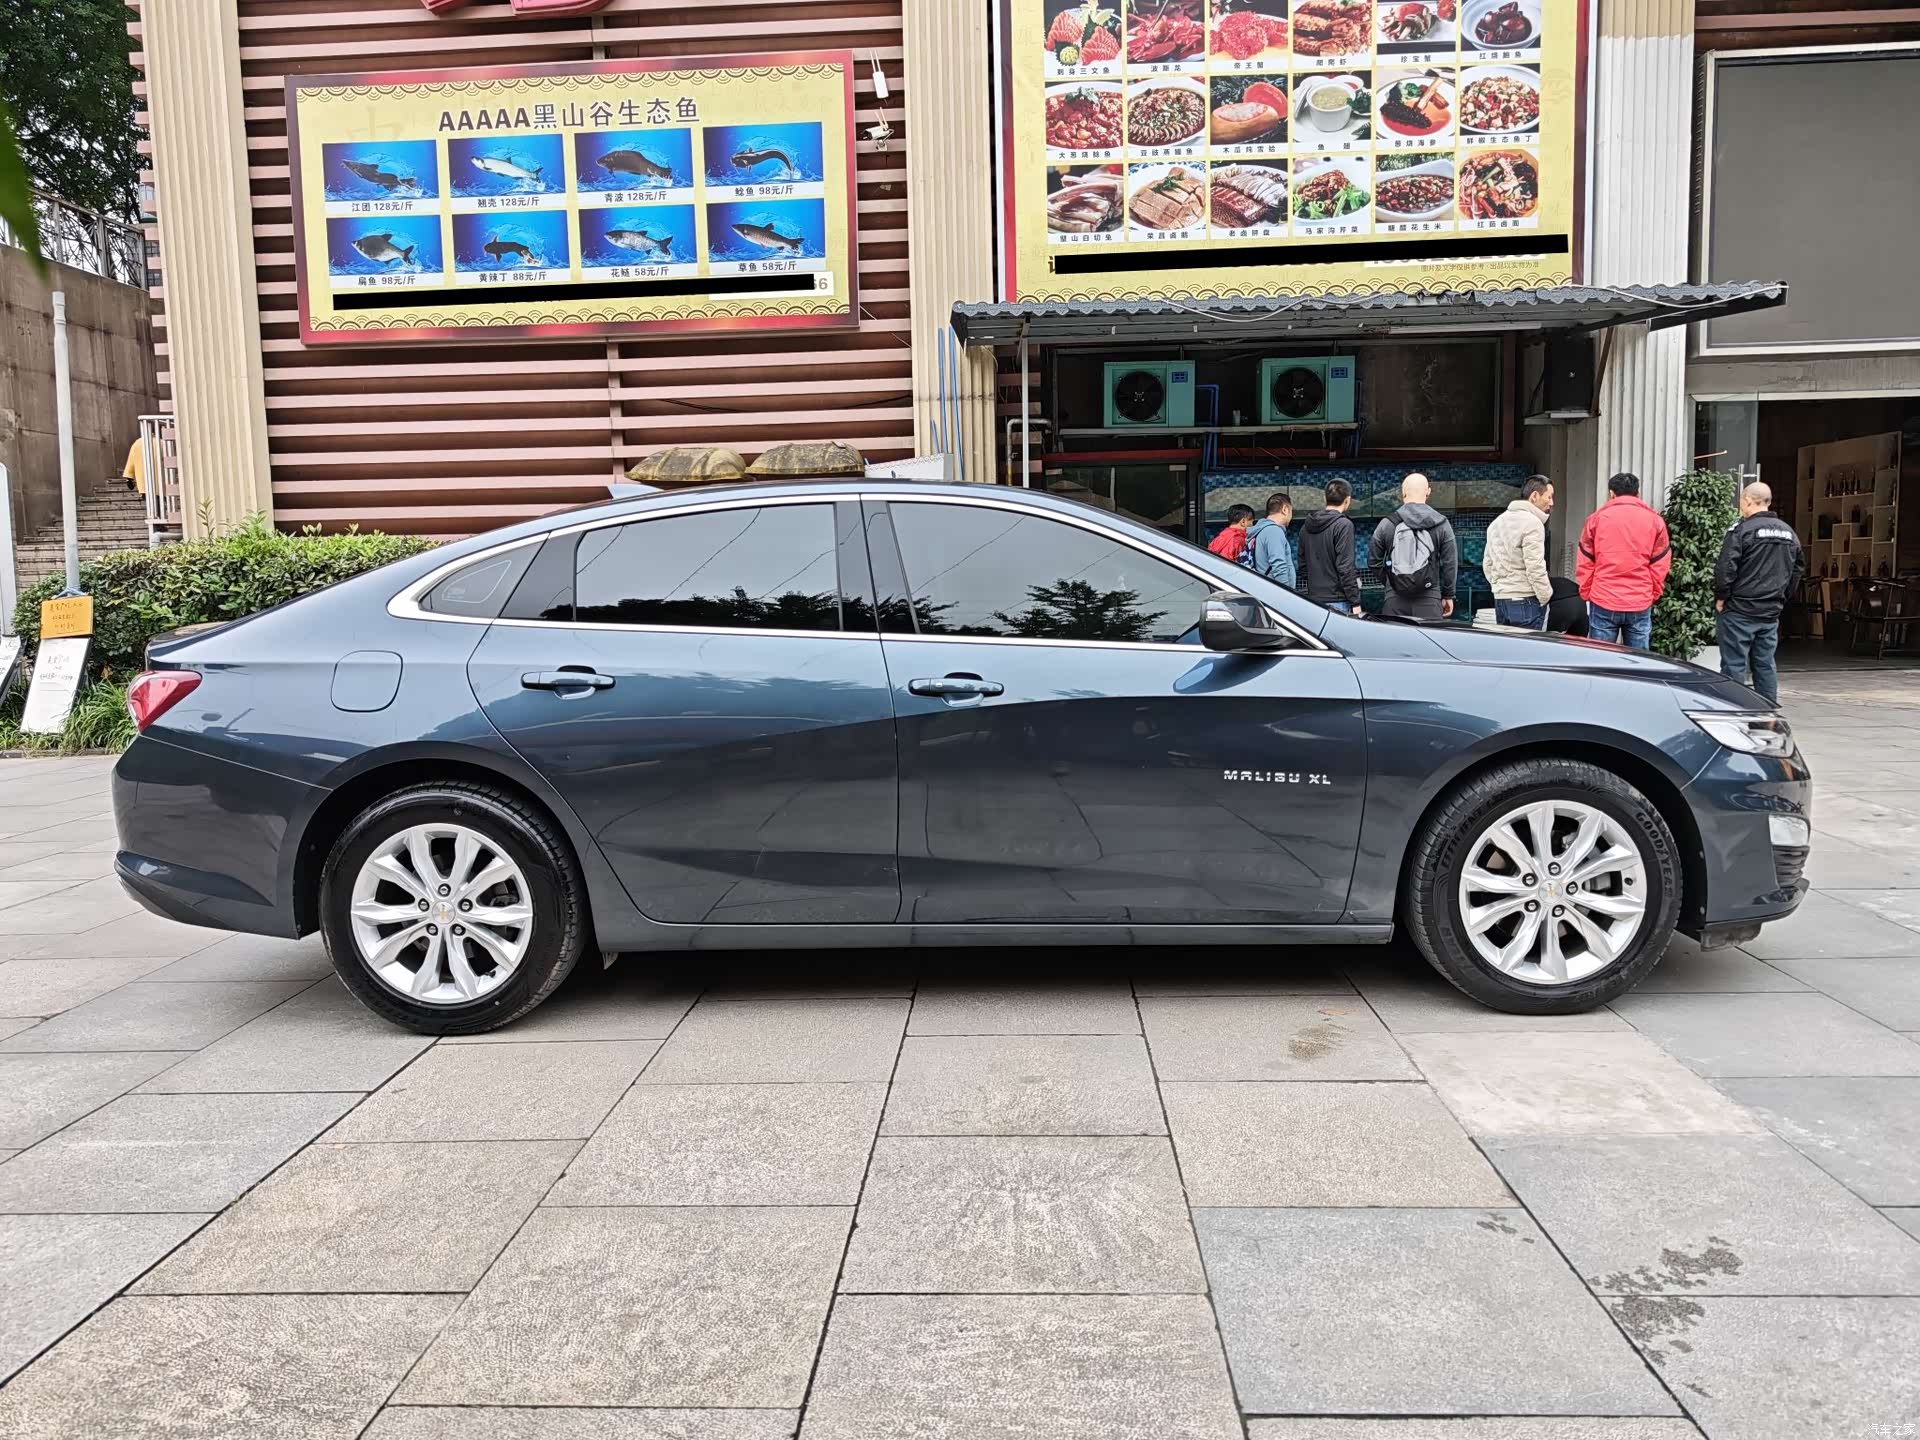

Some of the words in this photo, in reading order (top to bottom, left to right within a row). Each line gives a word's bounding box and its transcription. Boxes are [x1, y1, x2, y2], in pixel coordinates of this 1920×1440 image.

[1233, 60, 1264, 71] 帝王蟹
[438, 96, 700, 132] AAAAA黑山谷生态鱼
[604, 192, 624, 203] 青波
[627, 190, 668, 201] 128元/斤
[735, 186, 754, 198] 鲶鱼
[759, 184, 794, 196] 98元/斤
[351, 202, 371, 212] 江团
[374, 200, 414, 211] 128元/斤
[500, 196, 540, 207] 128元/斤
[634, 265, 670, 276] 58元/斤
[737, 262, 758, 273] 草鱼
[762, 260, 797, 271] 58元/斤
[358, 276, 377, 287] 扁鱼
[381, 274, 416, 286] 98元/斤
[479, 271, 508, 283] 黄辣丁
[512, 270, 547, 281] 88元/斤
[1223, 769, 1300, 783] MALIBU
[1308, 773, 1331, 785] XL
